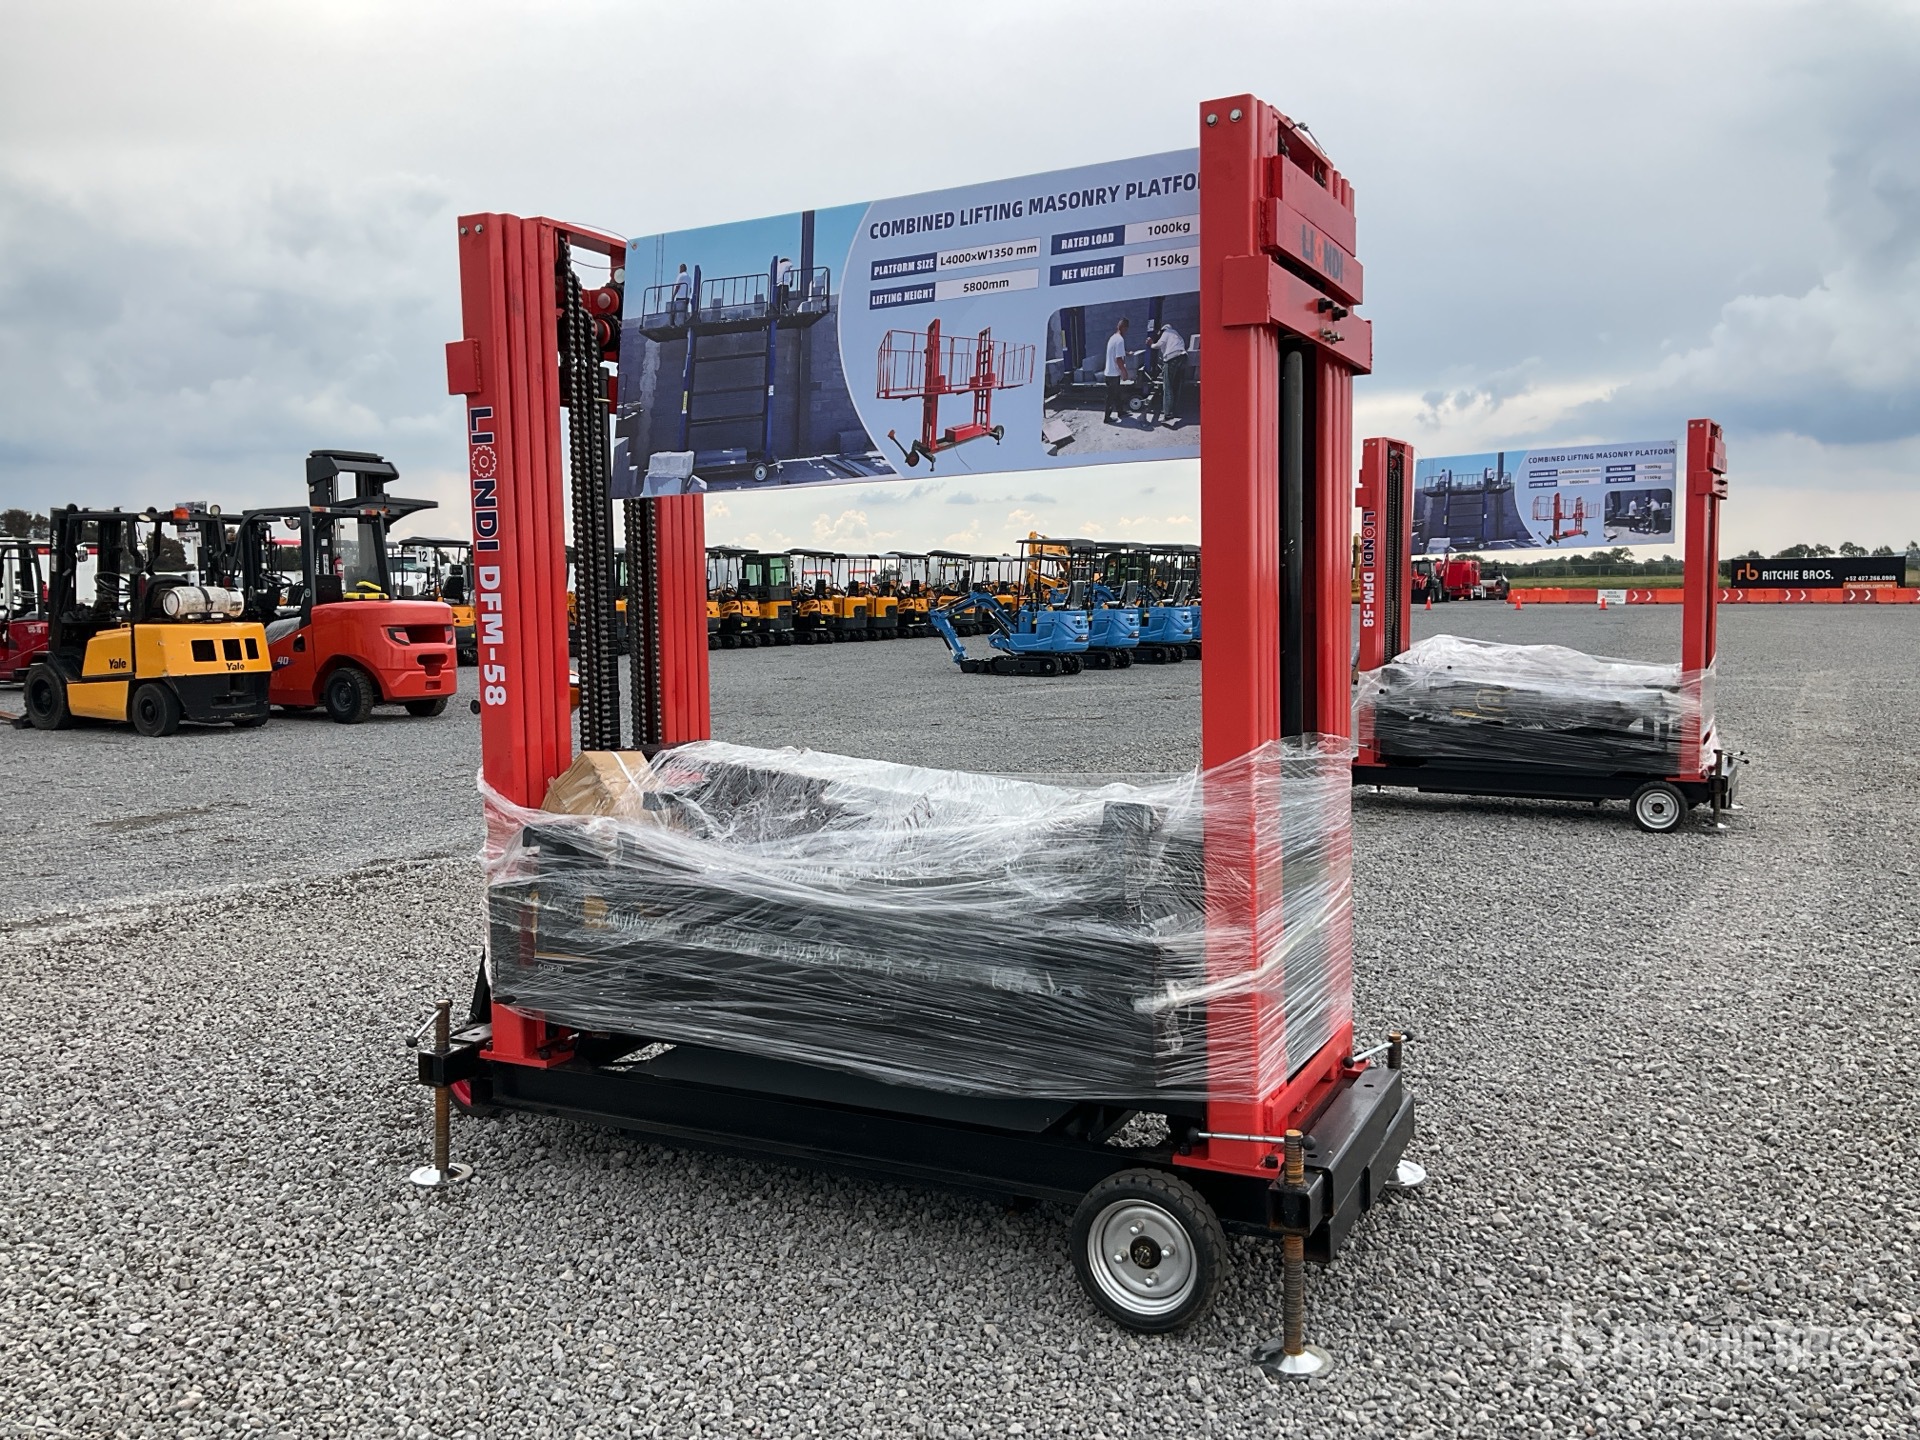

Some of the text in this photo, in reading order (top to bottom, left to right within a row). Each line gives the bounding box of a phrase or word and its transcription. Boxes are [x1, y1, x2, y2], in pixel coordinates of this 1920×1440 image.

[869, 171, 1200, 240] COMBINED LIFTING MASONRY PLATFO
[1061, 221, 1191, 250] RATED LOAD 1000kg
[873, 261, 915, 276] PLATFORM
[916, 258, 934, 271] SIZE
[1016, 244, 1037, 255] mm
[1061, 253, 1190, 281] NET WEIGHT 1150kg
[872, 278, 1009, 306] LIFTING HEIGHT 5800mm
[1528, 447, 1675, 465] COMBINED LIFTING MASONRY PLATFORM
[418, 550, 428, 562] 12
[1736, 562, 1835, 581] rb RITCHIE BROS.
[1362, 571, 1375, 628] DFM-58
[478, 565, 507, 706] DFM-58
[108, 658, 127, 670] Yale
[226, 662, 245, 671] Yale
[277, 656, 290, 665] 40
